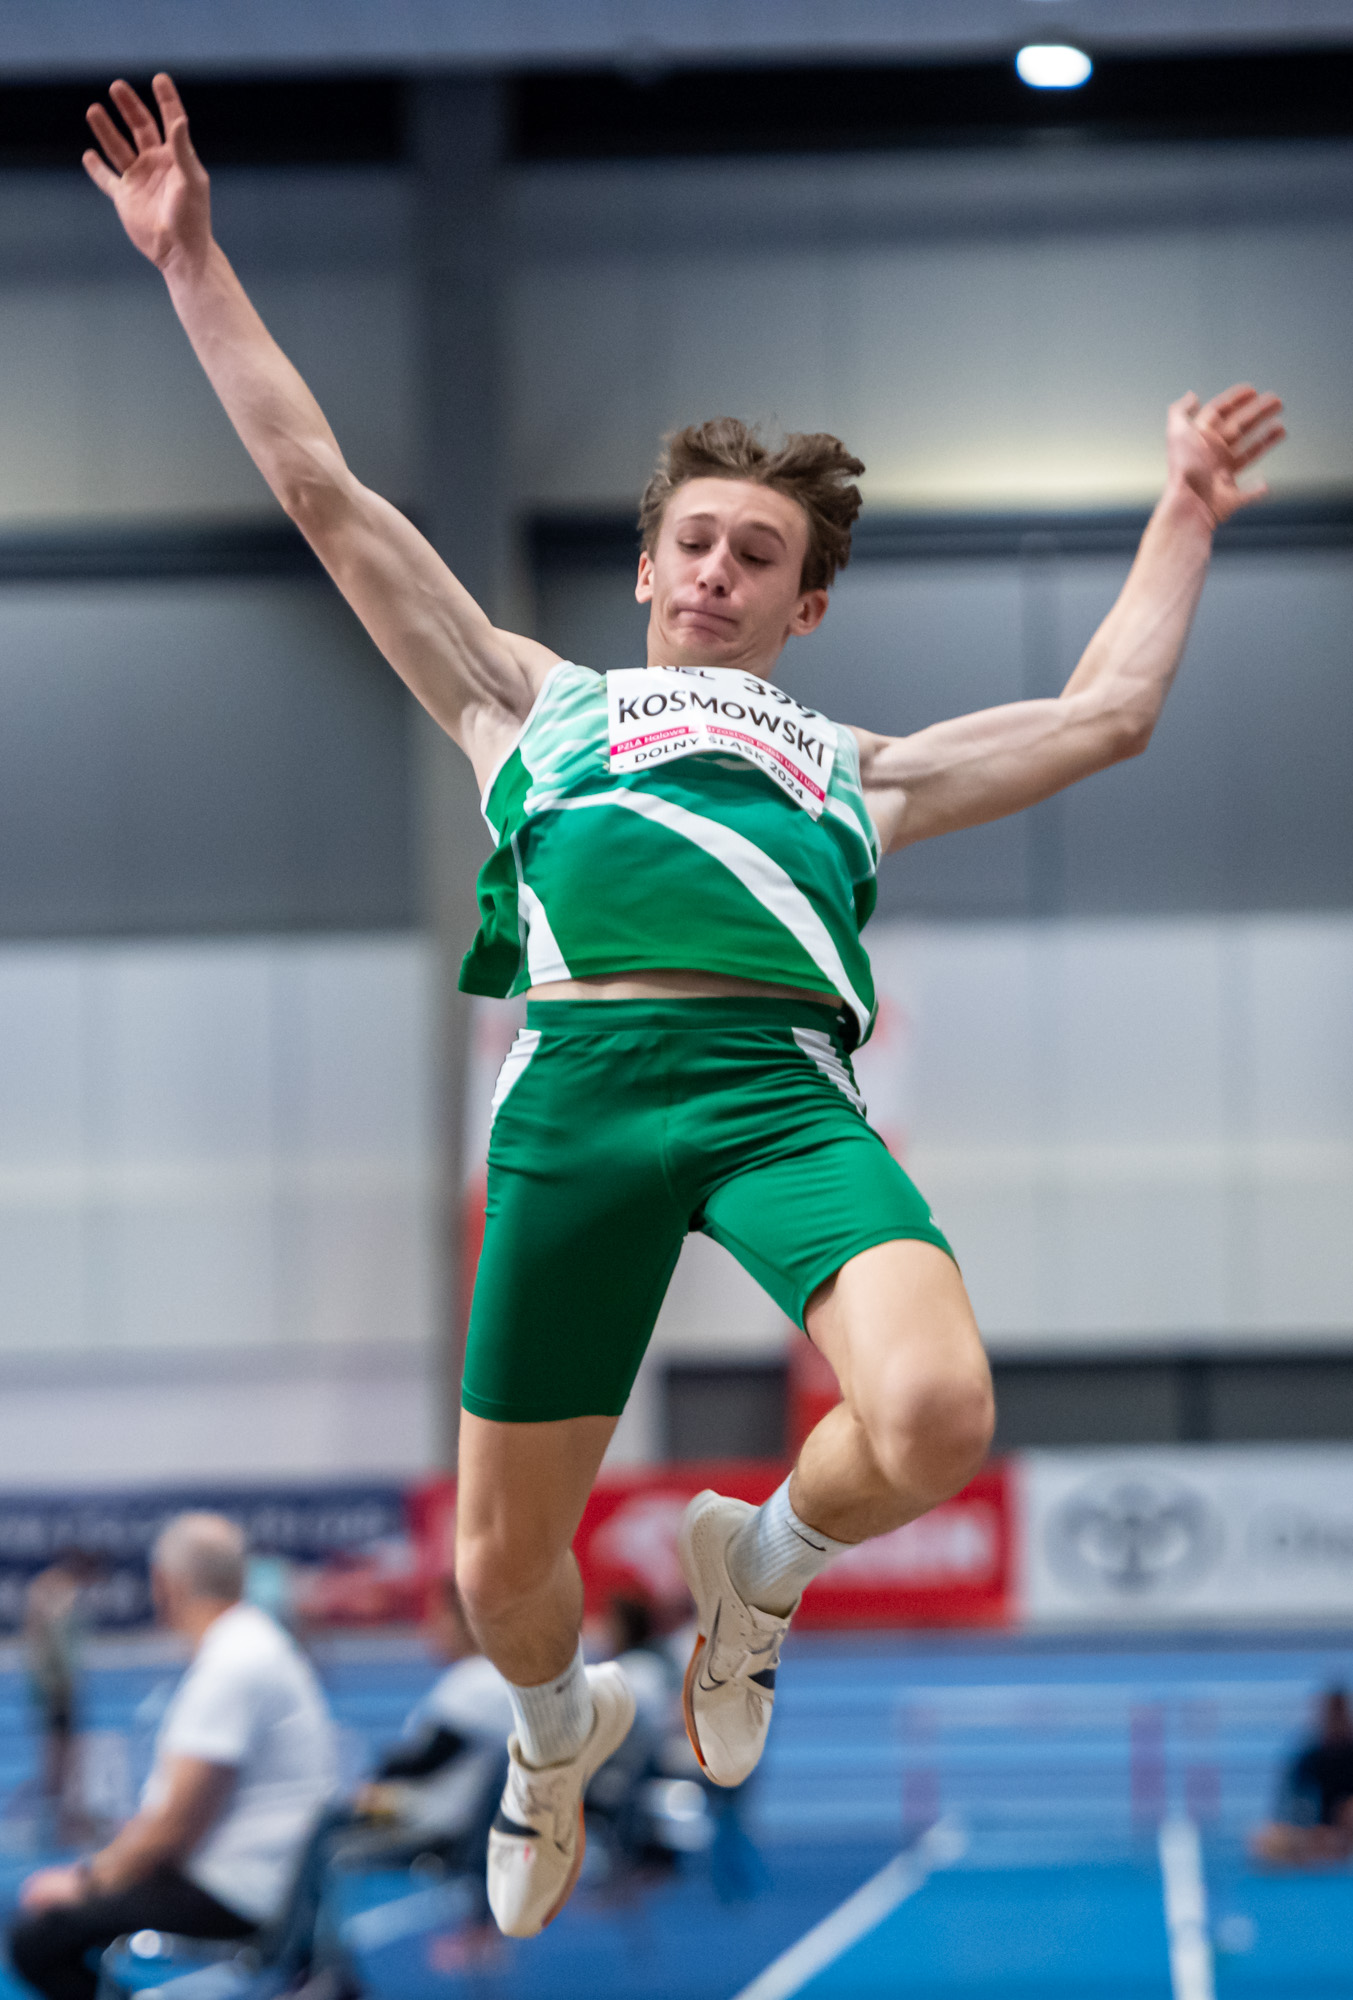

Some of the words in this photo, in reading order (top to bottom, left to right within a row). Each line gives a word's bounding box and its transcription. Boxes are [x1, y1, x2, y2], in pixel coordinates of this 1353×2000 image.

[617, 738, 642, 753] PZLA
[644, 727, 687, 743] Halowe
[618, 690, 825, 768] KOSMOWSKI
[634, 737, 699, 763] DOLNY
[769, 762, 804, 799] 2024
